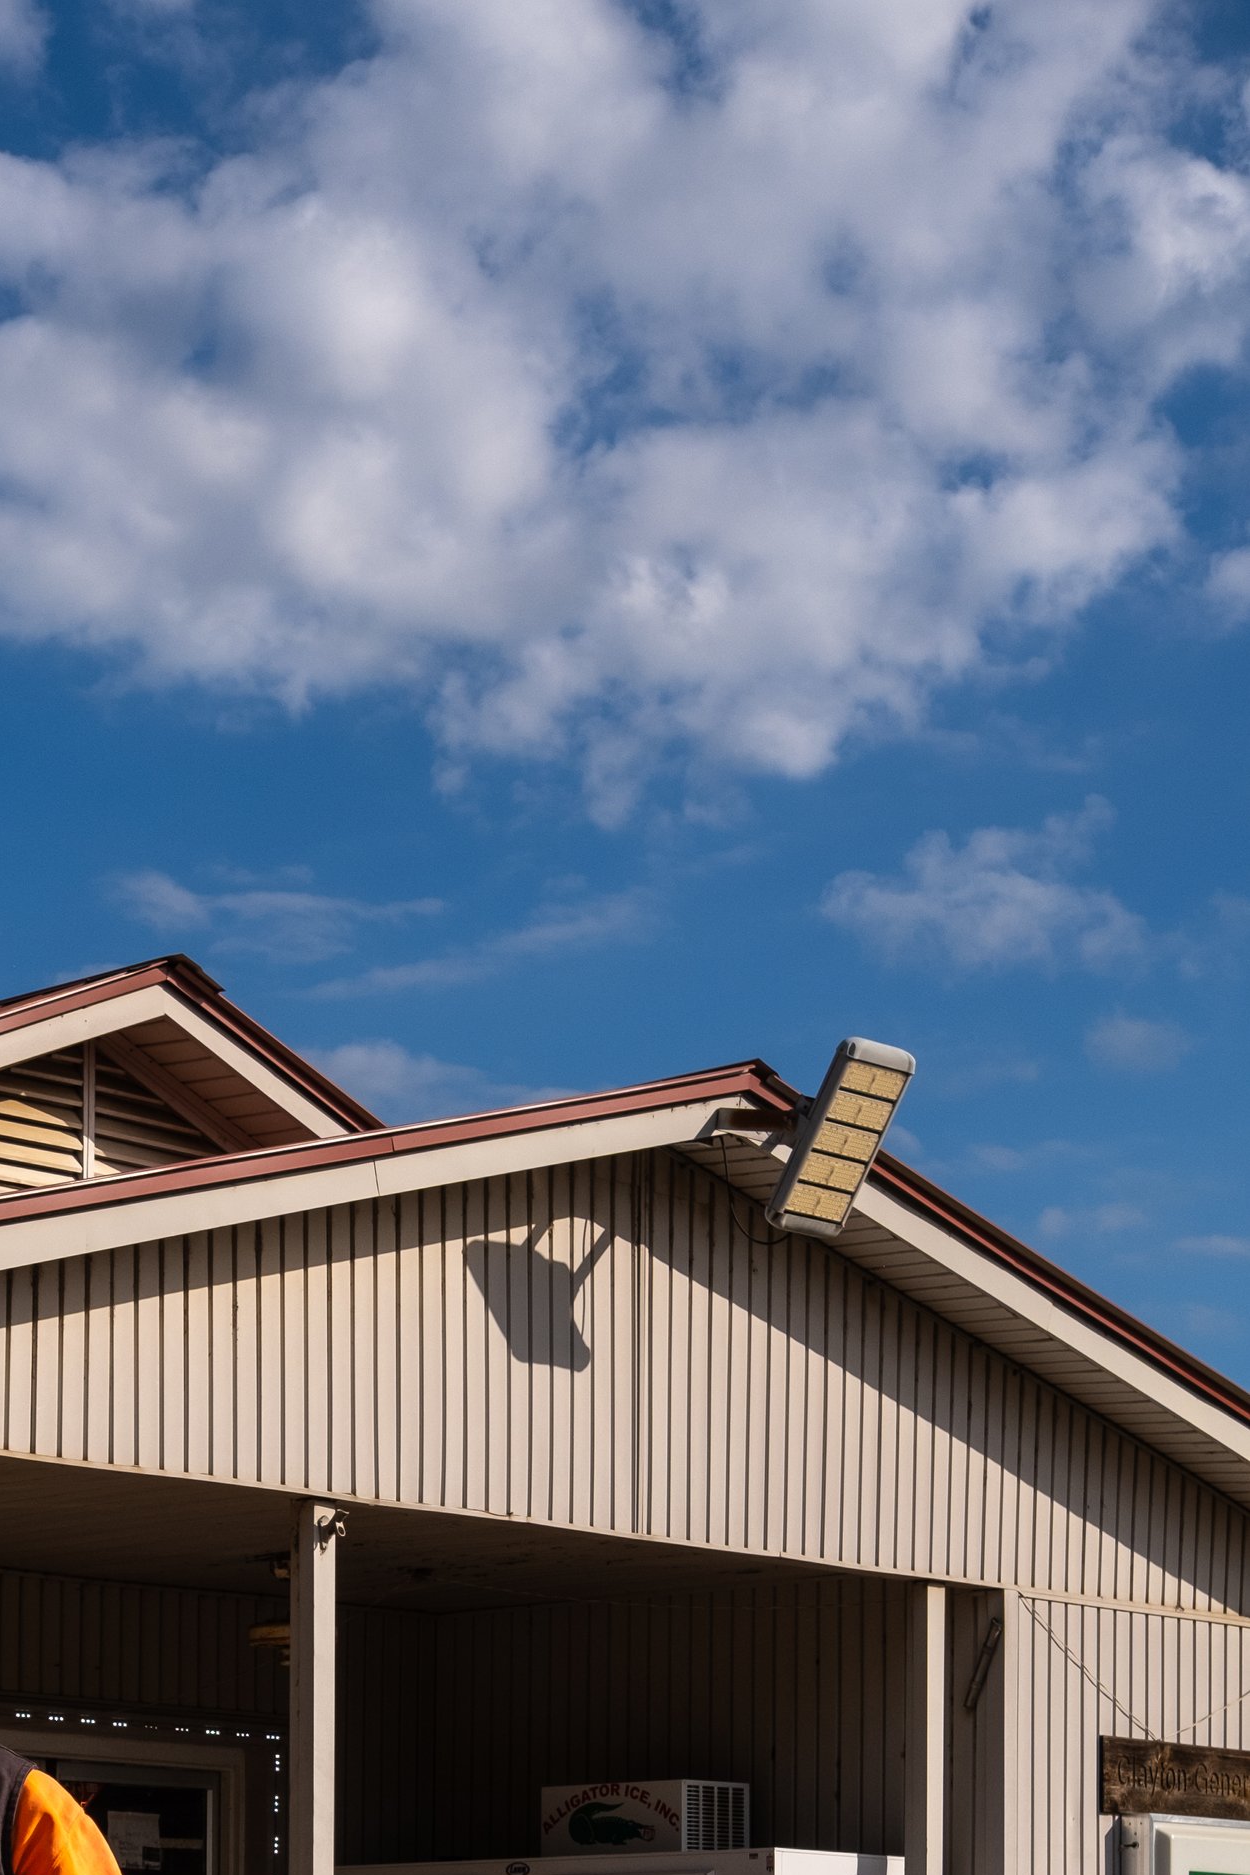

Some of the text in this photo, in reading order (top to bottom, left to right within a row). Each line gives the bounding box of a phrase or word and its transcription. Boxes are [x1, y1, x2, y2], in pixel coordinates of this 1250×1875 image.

[1117, 1757, 1187, 1797] Clayton
[543, 1784, 680, 1834] ALLIGATOR ICE, INC.
